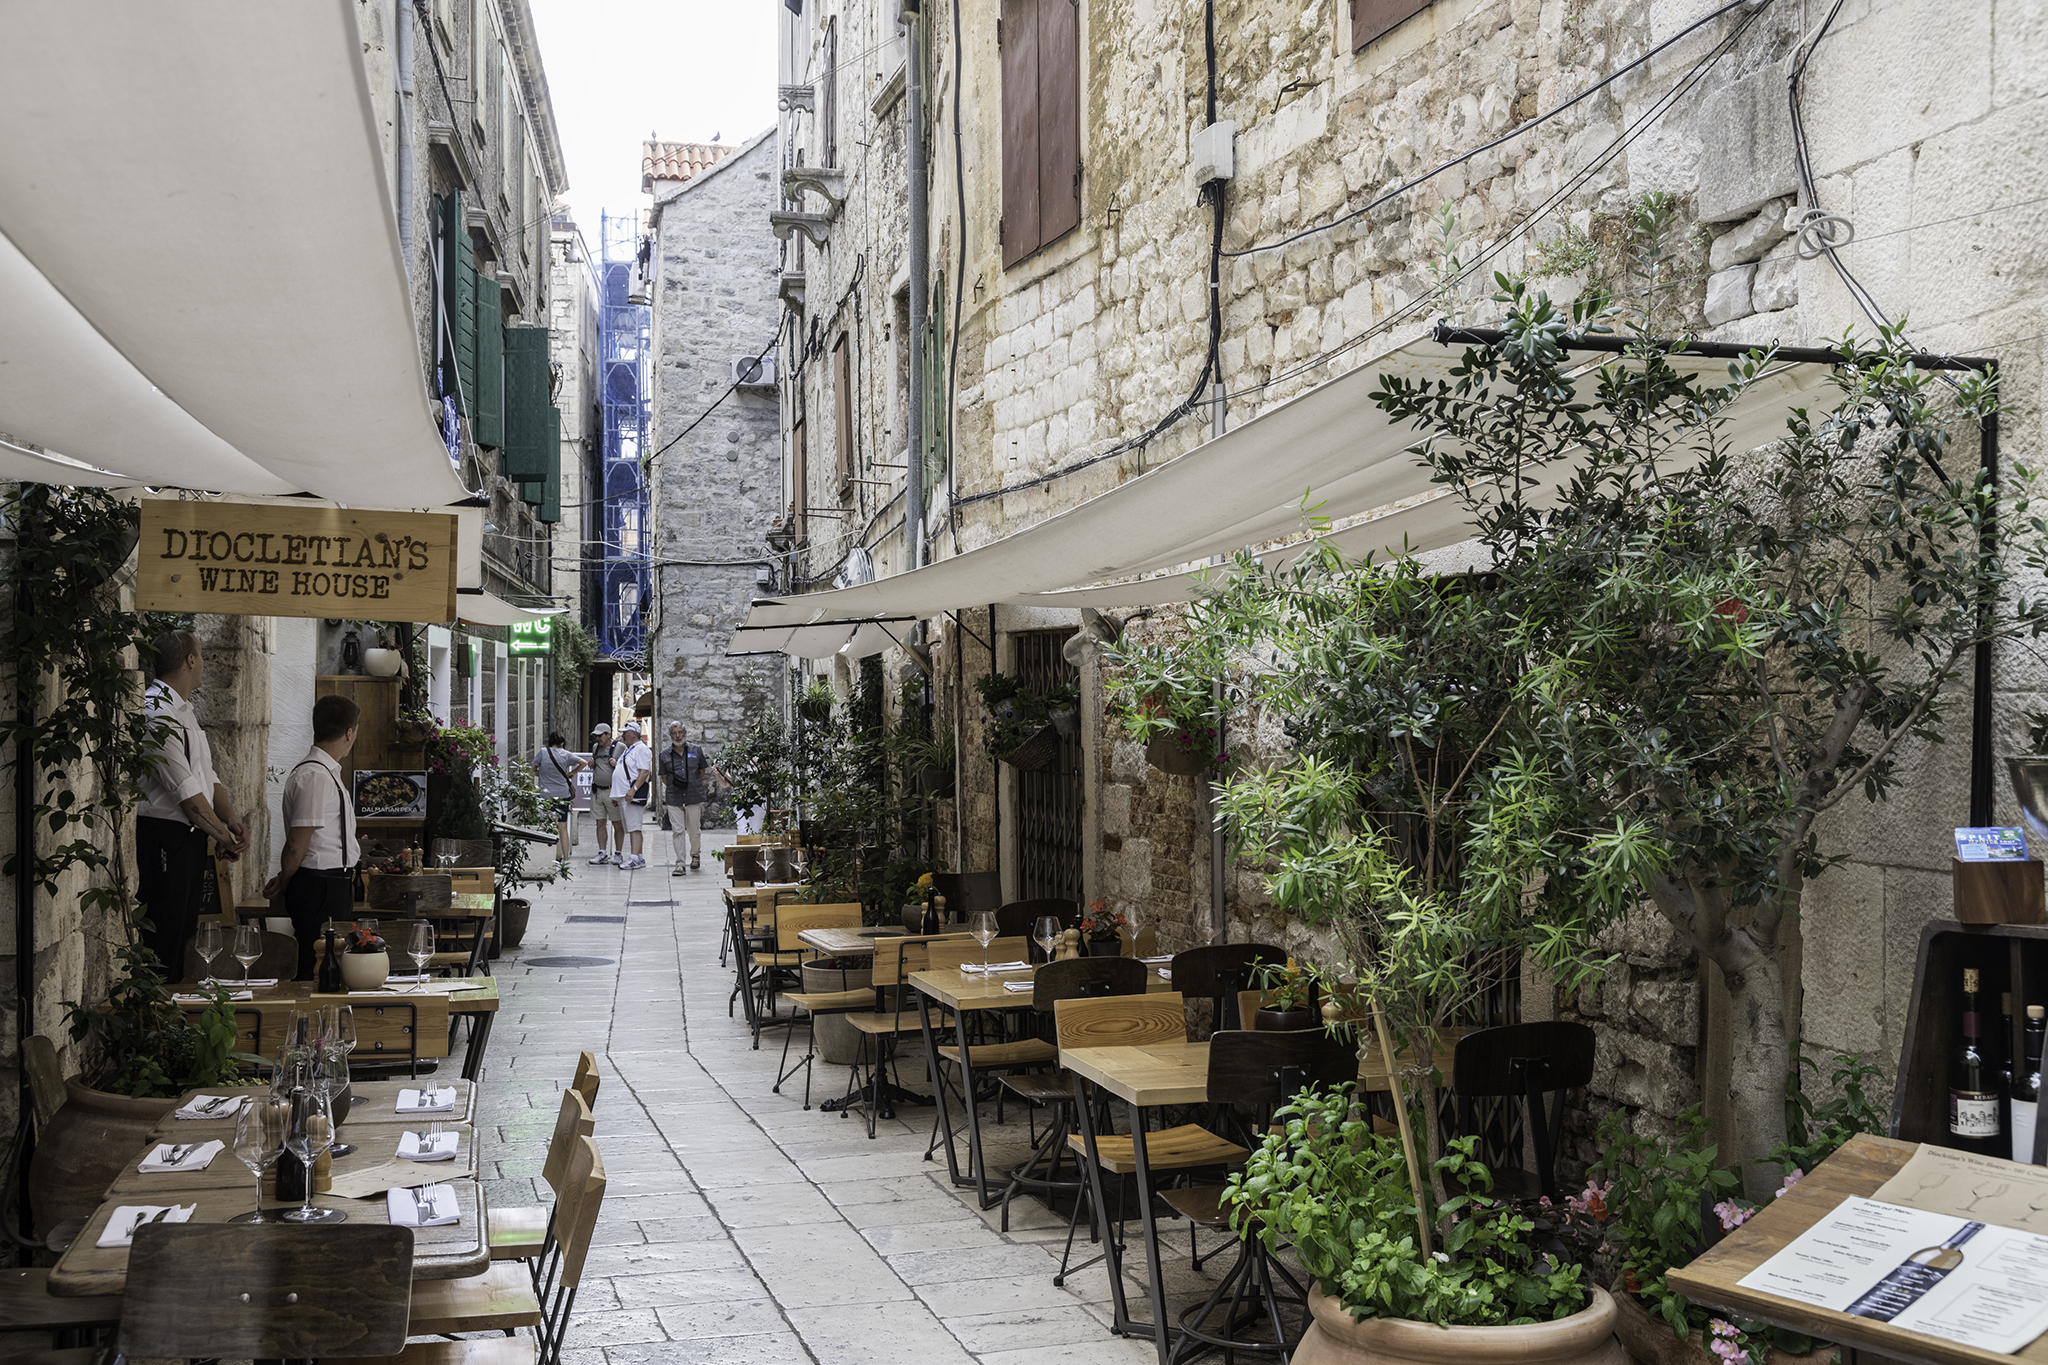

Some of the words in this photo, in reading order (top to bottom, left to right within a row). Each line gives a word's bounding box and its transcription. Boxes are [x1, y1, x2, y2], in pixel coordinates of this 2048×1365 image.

[160, 528, 429, 570] DIOCLETIAN'S
[199, 567, 279, 594] WINE
[291, 571, 390, 599] HOUSE
[513, 617, 551, 634] WC
[1927, 1150, 1965, 1162] Diocletian's
[1967, 1157, 1985, 1166] Wine
[1986, 1161, 2007, 1171] House
